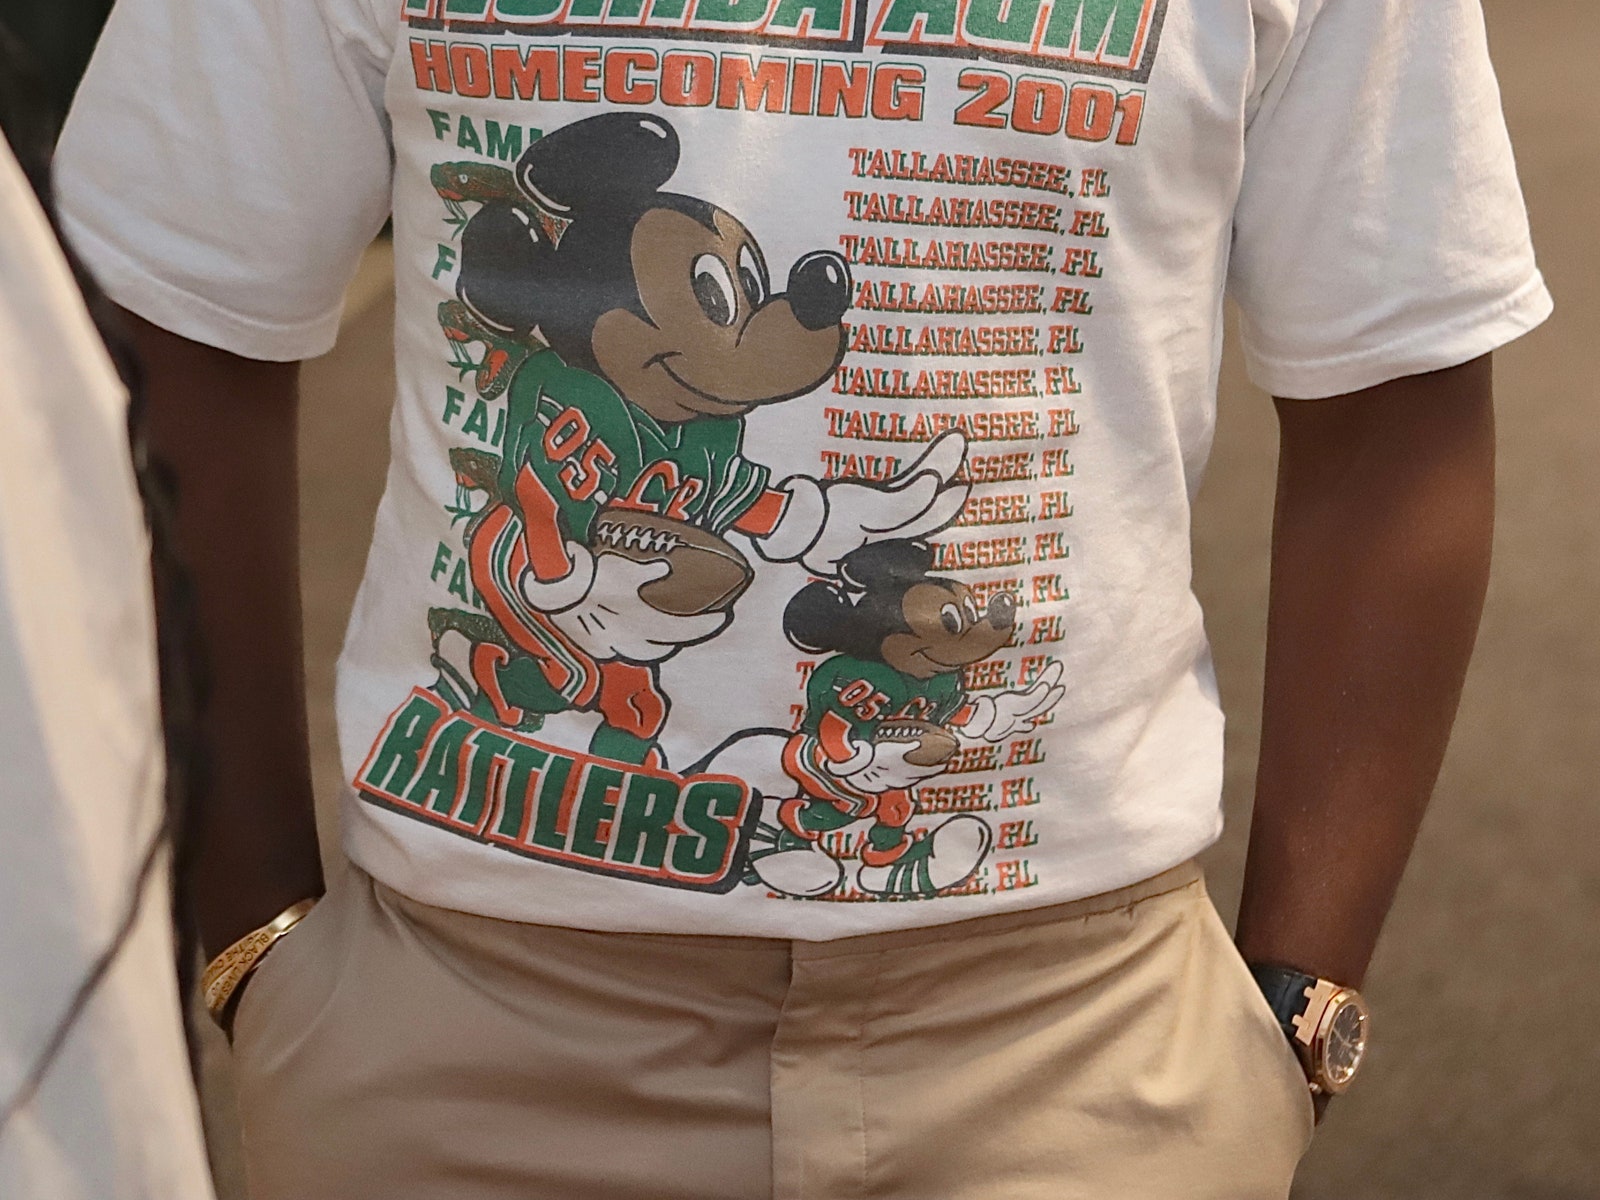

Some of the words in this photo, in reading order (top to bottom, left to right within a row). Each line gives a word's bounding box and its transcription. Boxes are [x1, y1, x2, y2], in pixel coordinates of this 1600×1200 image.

[409, 36, 926, 122] HOMECOMING
[953, 66, 1147, 146] 2001
[1078, 168, 1111, 198] FL
[1068, 210, 1110, 238] FL
[1059, 248, 1104, 278] FL
[850, 279, 1048, 315] ALLAHASSEE,
[1050, 286, 1094, 315] FL
[1046, 324, 1084, 354] FL
[1043, 366, 1082, 396] FL
[1047, 408, 1080, 437] FL
[1040, 448, 1075, 478] FL
[1033, 531, 1070, 562] FL
[353, 686, 758, 890] RATTLERS
